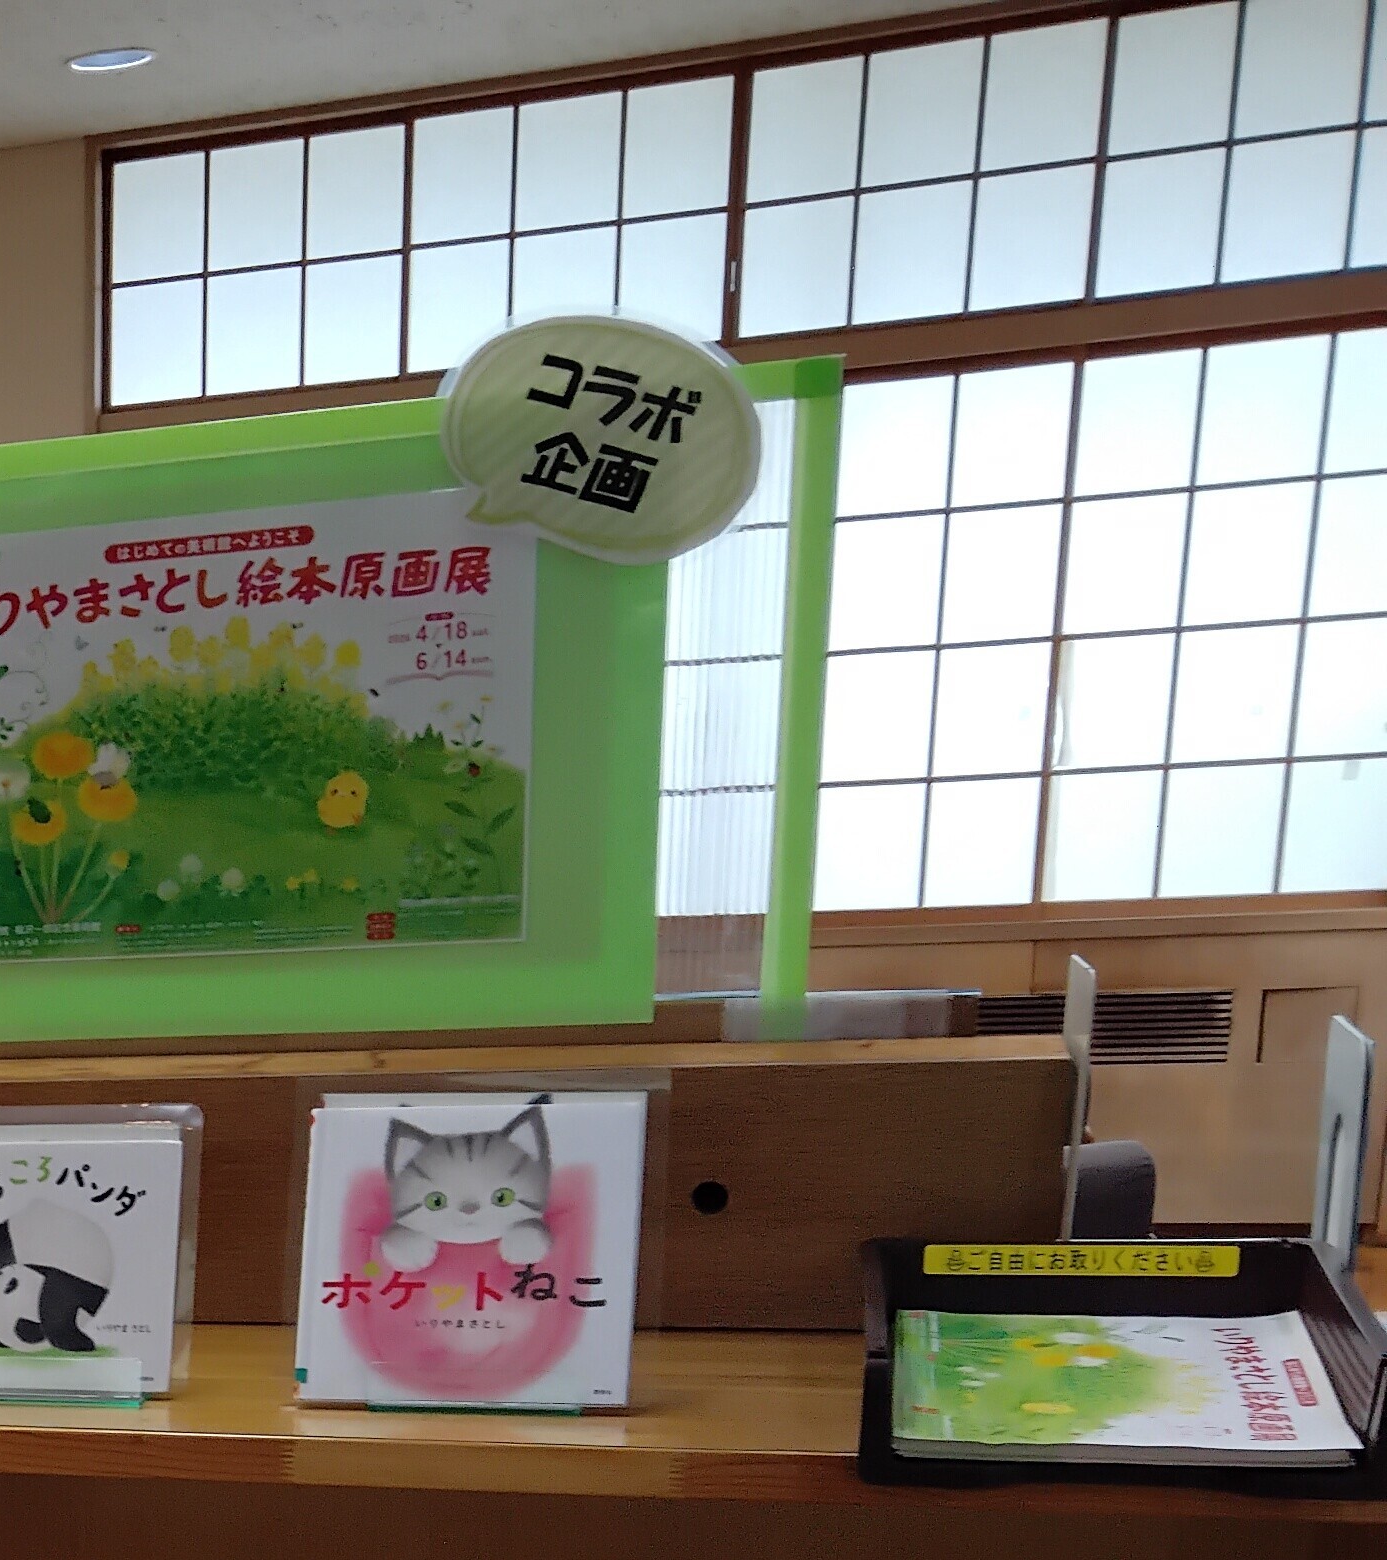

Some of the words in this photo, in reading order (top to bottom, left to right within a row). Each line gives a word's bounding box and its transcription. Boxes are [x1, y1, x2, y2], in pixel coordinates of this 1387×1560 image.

[526, 353, 702, 444] コラボ
[520, 431, 659, 514] 企画
[321, 1261, 608, 1312] ポケットねこ
[967, 1249, 1195, 1274] ご自由にお取りください
